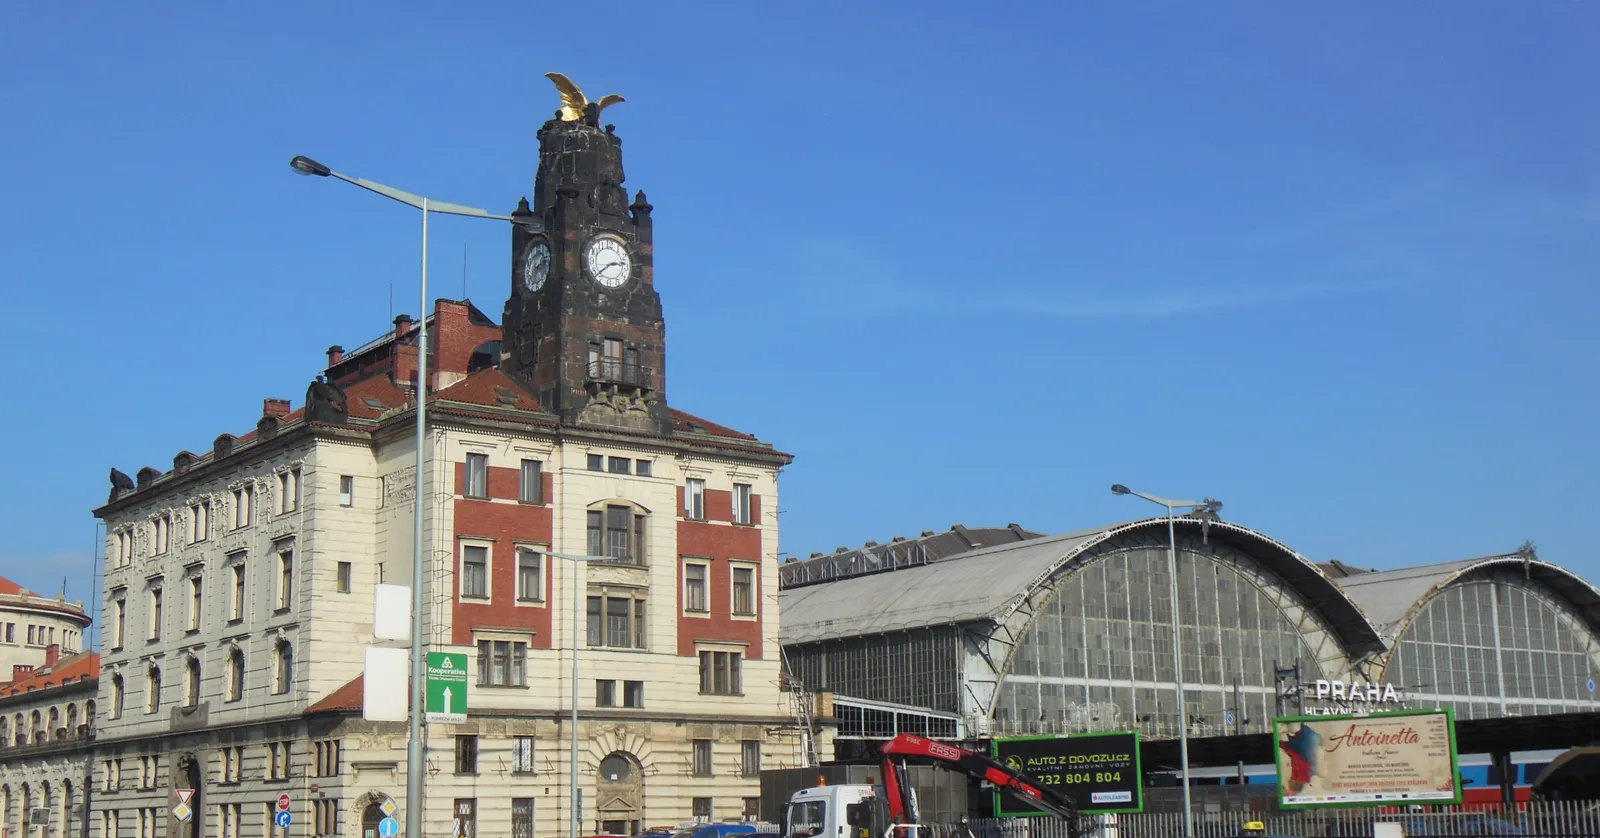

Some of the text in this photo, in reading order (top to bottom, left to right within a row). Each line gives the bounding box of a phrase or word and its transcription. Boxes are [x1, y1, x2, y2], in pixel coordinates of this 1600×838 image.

[428, 666, 466, 675] Kooperativa
[1316, 679, 1399, 703] PRAHA
[1325, 724, 1420, 752] Antoinetta
[931, 744, 958, 759] FASSI
[1027, 756, 1057, 766] AUTO
[1059, 756, 1066, 764] Z
[1037, 772, 1121, 785] 732 804 804
